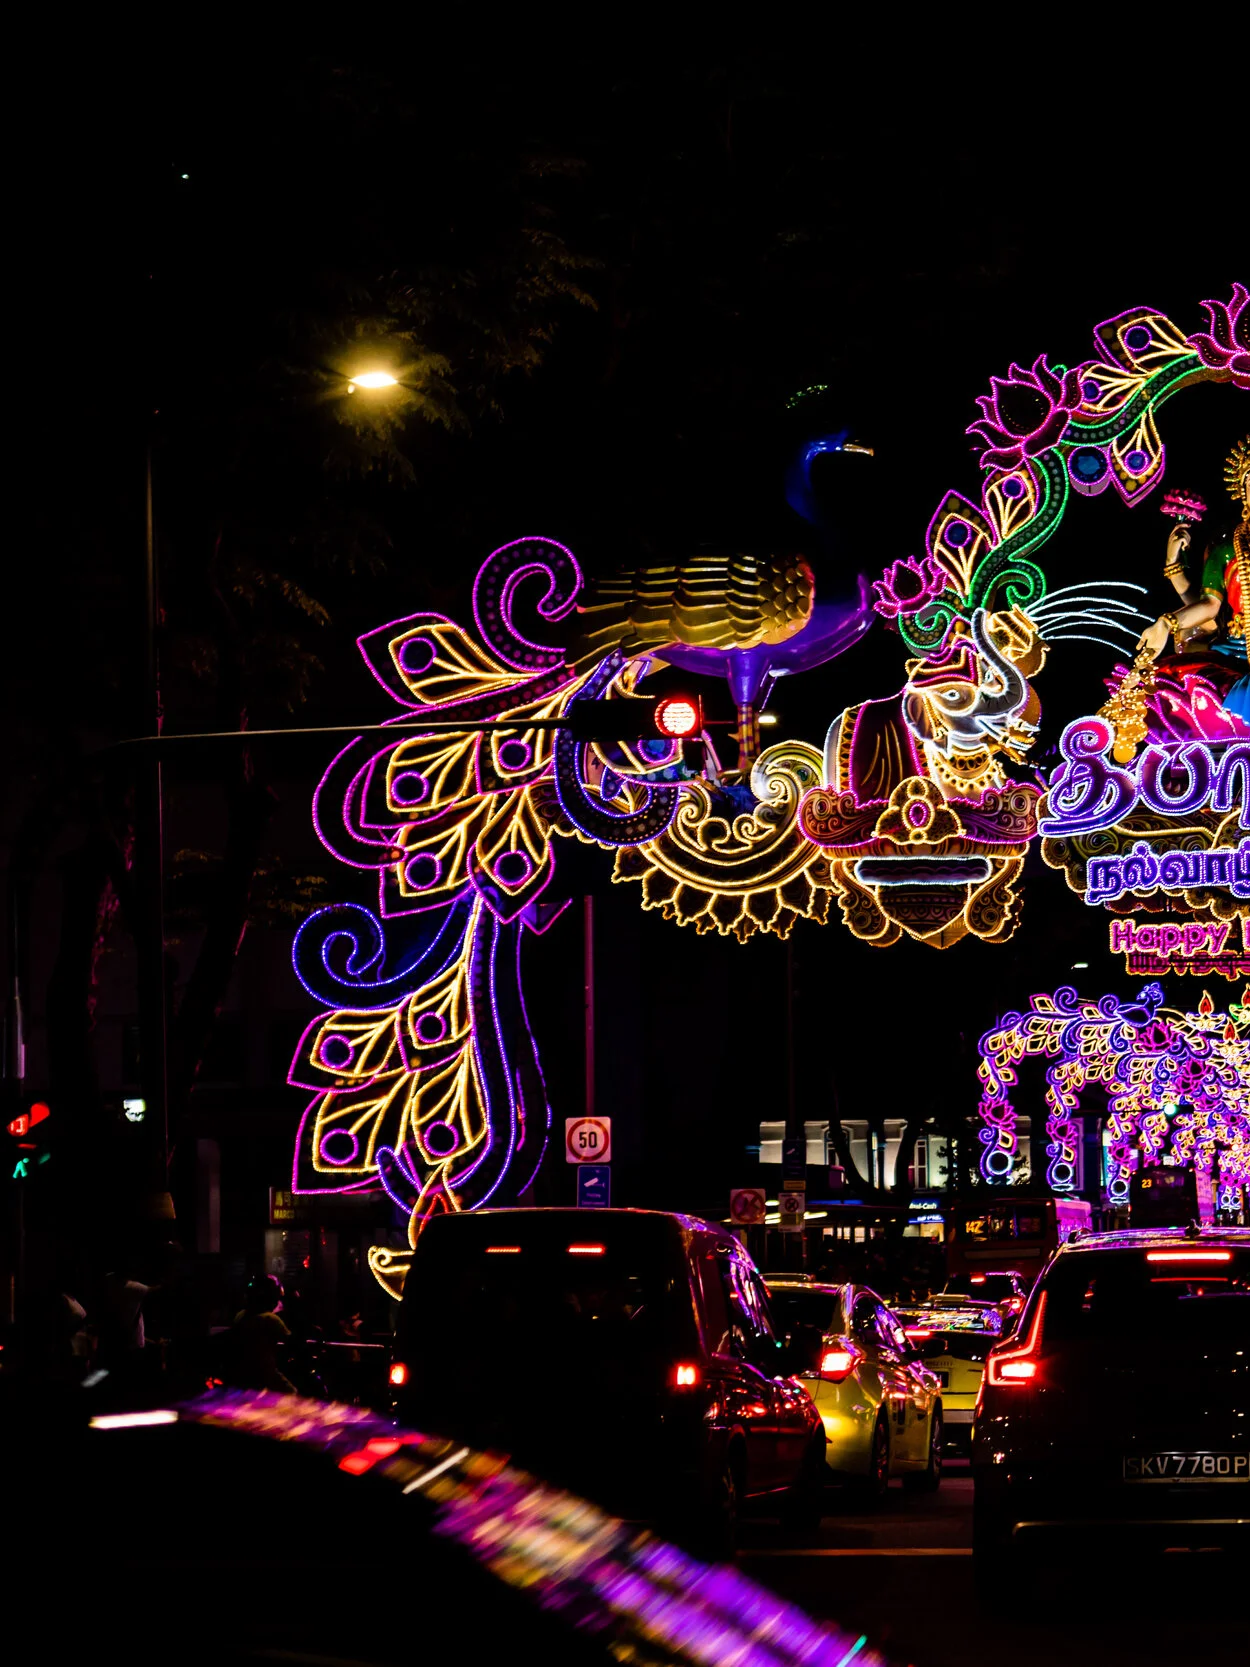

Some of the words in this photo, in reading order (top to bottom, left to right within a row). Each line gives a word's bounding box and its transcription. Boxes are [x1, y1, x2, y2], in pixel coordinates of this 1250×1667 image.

[1110, 919, 1231, 955] Happy
[579, 1132, 597, 1148] 50
[1141, 1178, 1152, 1188] 23
[1127, 1455, 1248, 1475] SKV7780P
